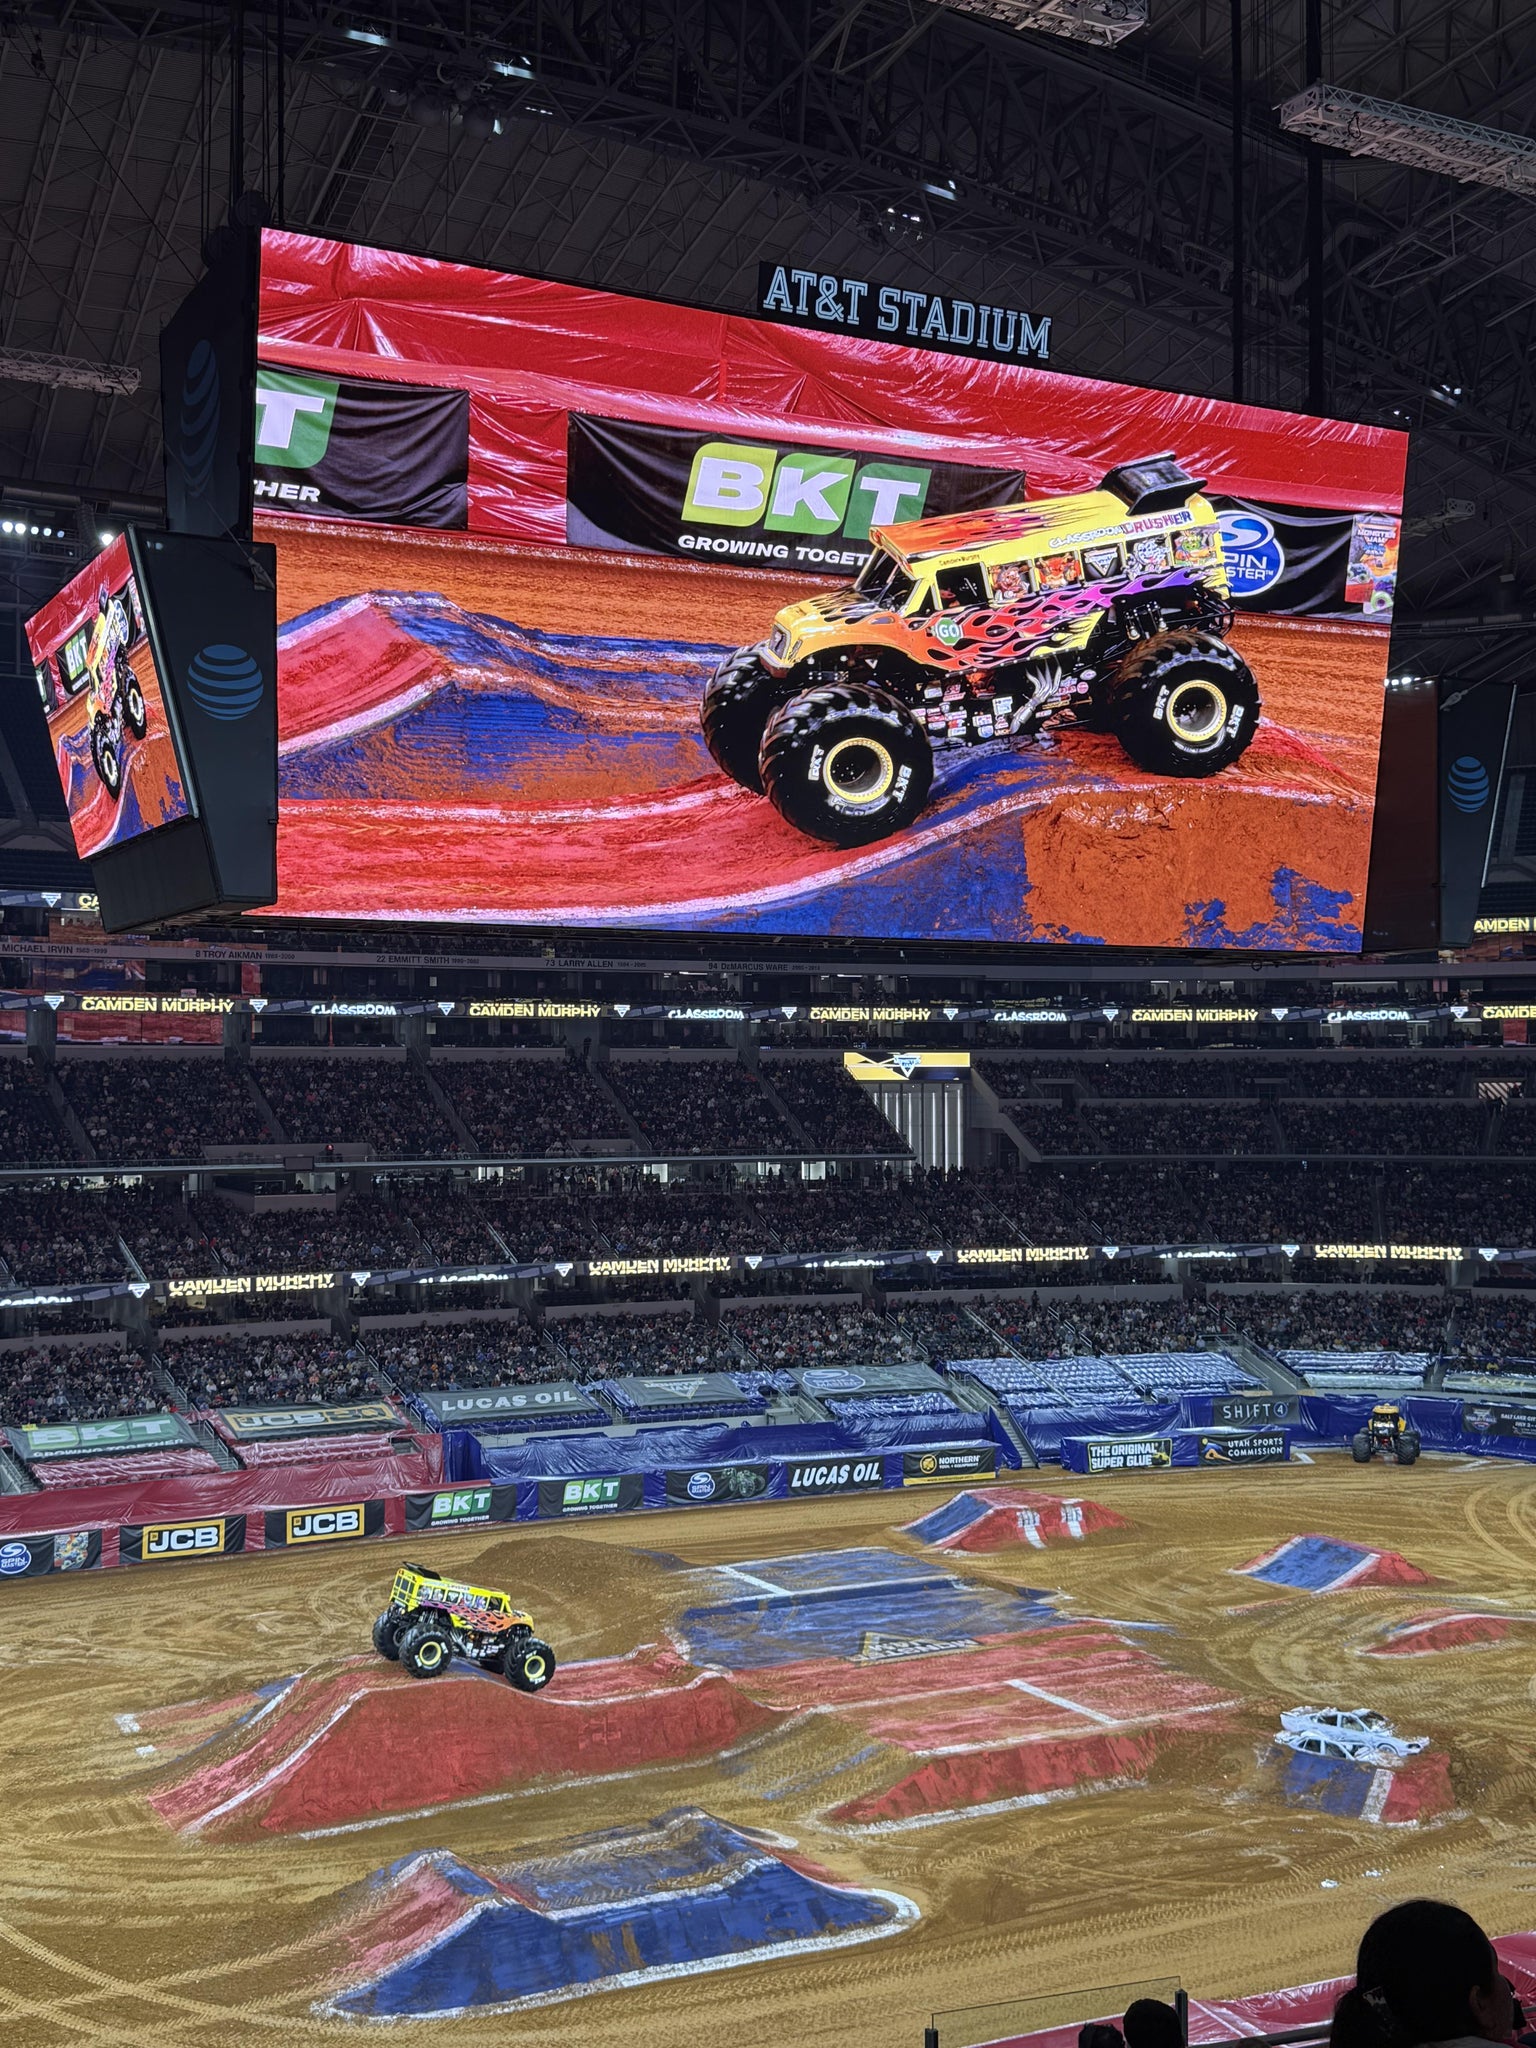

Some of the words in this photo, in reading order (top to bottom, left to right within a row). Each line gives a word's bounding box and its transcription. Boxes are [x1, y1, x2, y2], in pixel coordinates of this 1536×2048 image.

[763, 266, 868, 325] AT&T
[877, 286, 1052, 358] STADIUM
[692, 456, 921, 526] BKT
[1122, 510, 1194, 536] CRUSHER
[677, 535, 788, 558] GROWING
[795, 547, 874, 567] TOGET
[1225, 552, 1267, 570] PIN
[940, 624, 960, 637] GO
[1474, 917, 1530, 933] AMDEN
[2, 944, 46, 953] MICHAEL
[48, 945, 73, 954] IRVIN
[195, 950, 201, 958] 8
[203, 950, 227, 959] TROY
[228, 951, 263, 960] AIKMAN
[376, 955, 386, 963] 22
[388, 955, 421, 964] EMMITT
[424, 957, 450, 965] SMITH
[558, 960, 585, 968] LARRY
[81, 998, 157, 1011] CAMDEN
[162, 998, 235, 1012] MURPHY
[469, 1004, 535, 1017] CAMDEN
[538, 1005, 601, 1017] MURPHY
[810, 1008, 870, 1021] CAMDEN
[873, 1009, 931, 1021] MURPHY
[1132, 1009, 1193, 1022] CAMDEN
[1197, 1009, 1259, 1022] MURPHY
[442, 1394, 527, 1412] LUCAS
[535, 1391, 578, 1404] OIL
[1222, 1404, 1271, 1419] SHIFT
[239, 1411, 325, 1427] JCB
[32, 1419, 170, 1445] BKT
[1090, 1446, 1110, 1456] THE
[1111, 1443, 1156, 1455] ORIGINAL
[1228, 1440, 1250, 1448] UTAH
[1253, 1437, 1283, 1447] SPORTS
[1228, 1447, 1283, 1457] COMMISSION
[938, 1455, 980, 1465] NORTHERN
[1091, 1456, 1124, 1469] SUPER
[1126, 1455, 1153, 1467] GLUE
[791, 1463, 850, 1488] LUCAS
[853, 1462, 881, 1482] OIL
[566, 1481, 619, 1500] BKT
[434, 1492, 491, 1514] BKT
[589, 1503, 618, 1511] TOGETHER
[293, 1511, 359, 1537] JCB
[431, 1518, 458, 1527] GROWING
[459, 1514, 490, 1524] TOGETHER
[150, 1526, 219, 1552] JCB
[1, 1556, 26, 1564] SPIN
